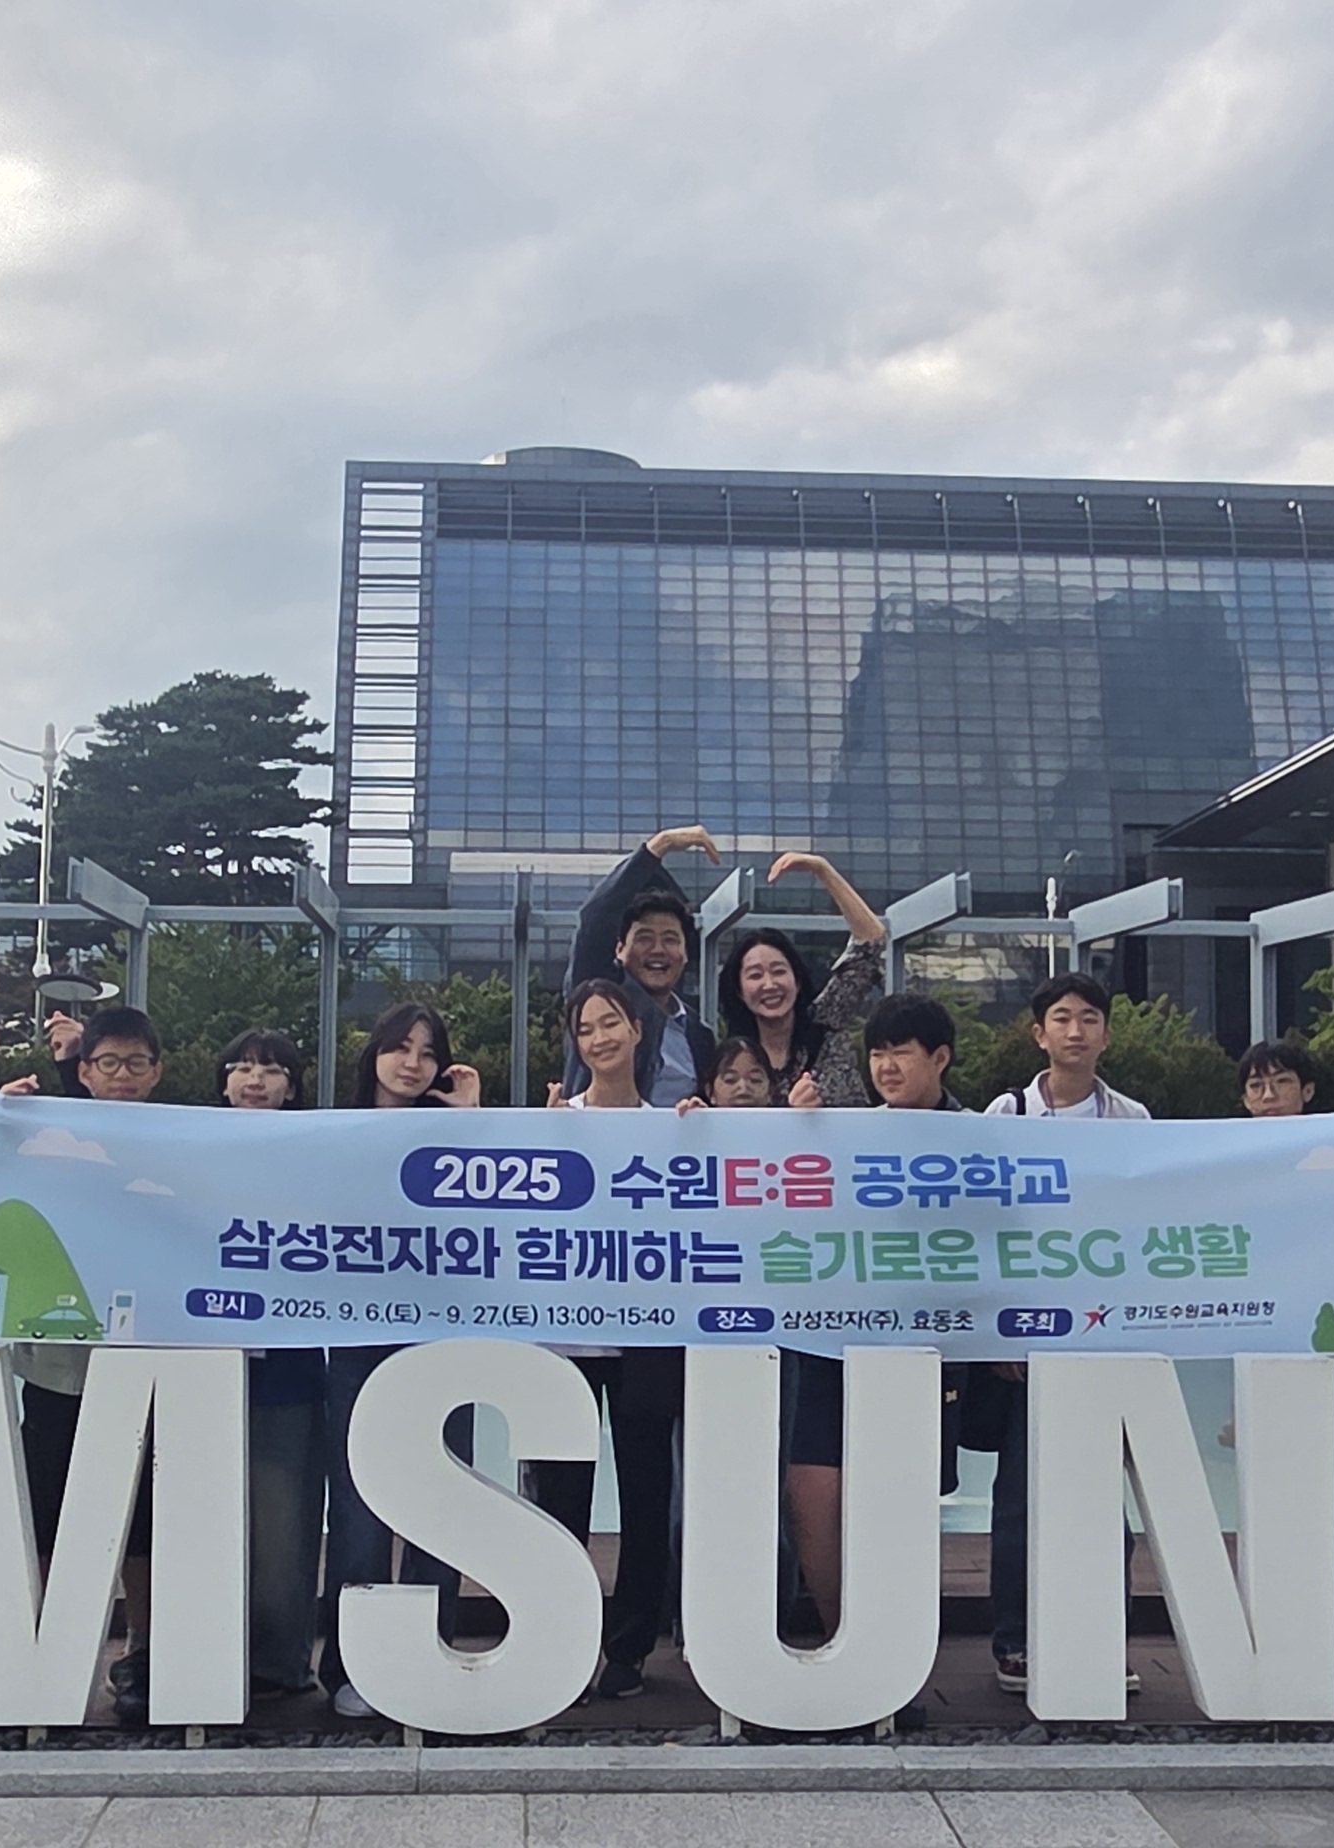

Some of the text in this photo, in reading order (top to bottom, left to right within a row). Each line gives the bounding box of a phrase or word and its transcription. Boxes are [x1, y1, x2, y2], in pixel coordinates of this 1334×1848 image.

[433, 1153, 1071, 1209] 2025 수원E:음 공유학교
[219, 1217, 1251, 1283] 삼성전자와 함께하는 슬기로운 ESG 생활
[205, 1291, 248, 1317] 일시
[271, 1299, 332, 1321] 2025.
[547, 1305, 675, 1326] 13:00~15:40
[715, 1309, 757, 1330] 장소
[910, 1309, 975, 1333] 효동초
[1014, 1309, 1055, 1334] 주최
